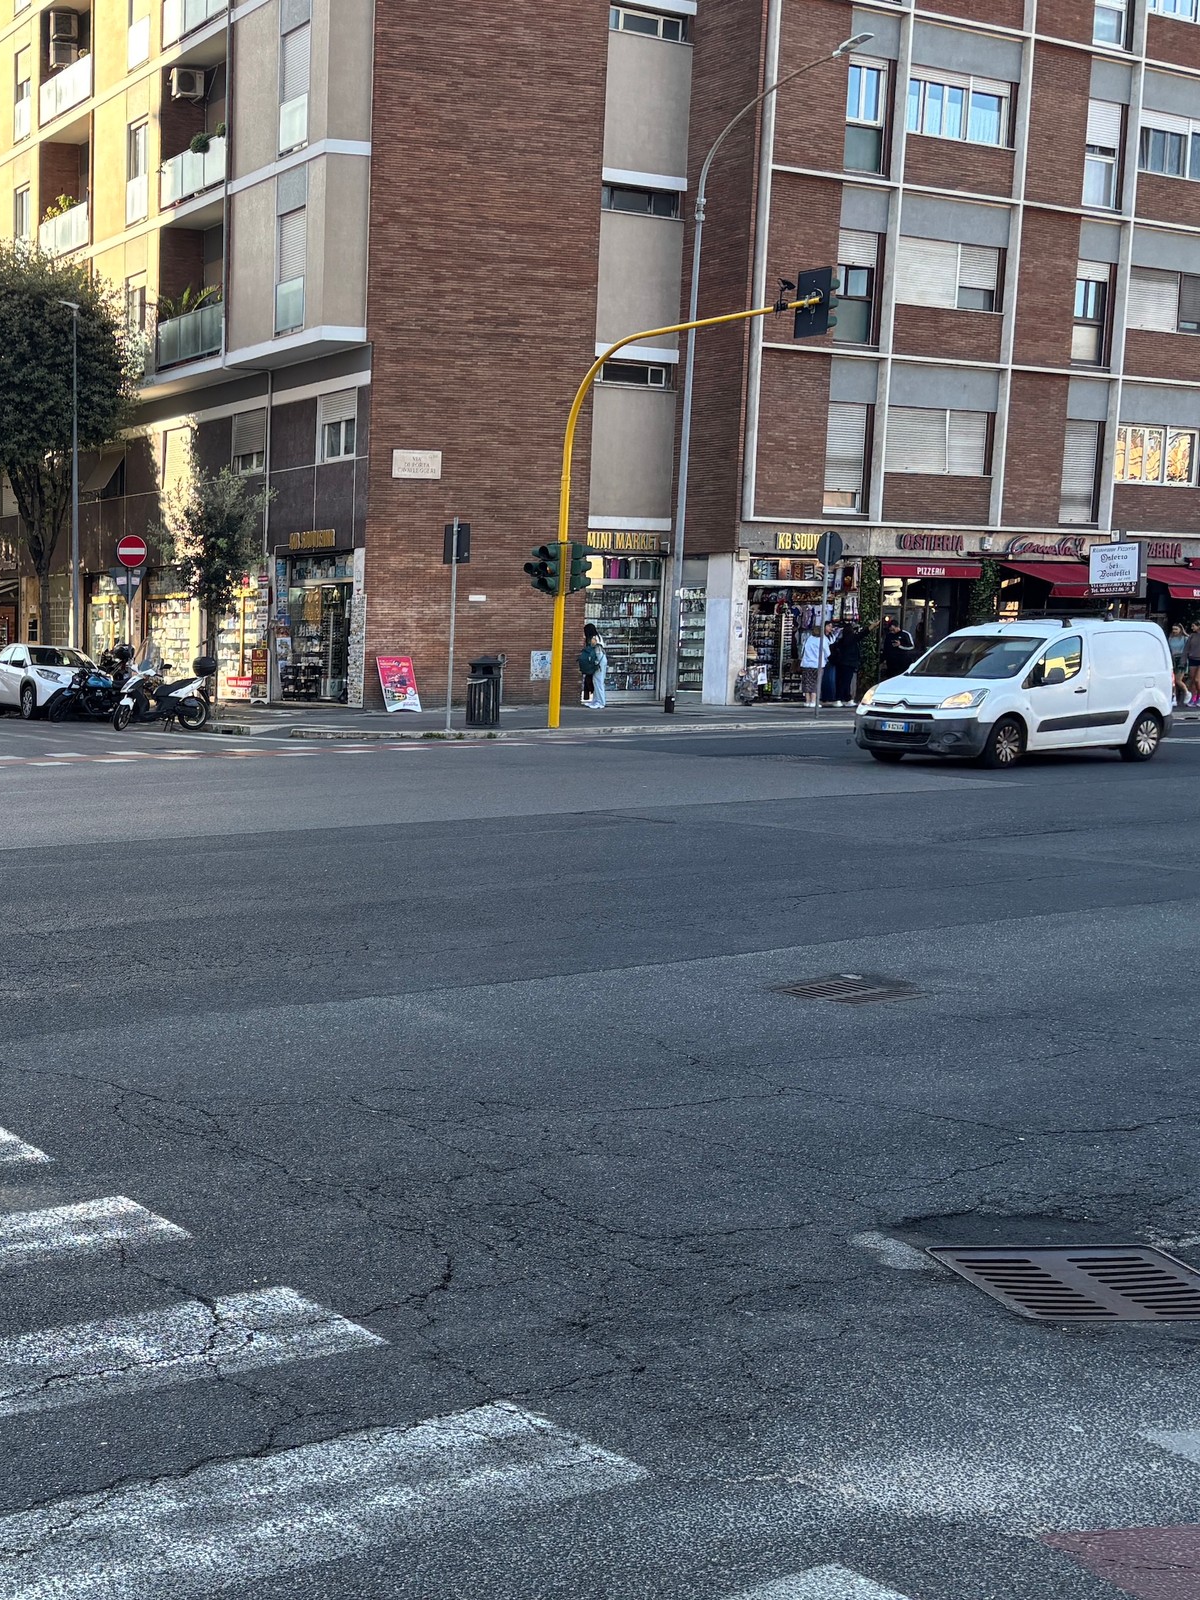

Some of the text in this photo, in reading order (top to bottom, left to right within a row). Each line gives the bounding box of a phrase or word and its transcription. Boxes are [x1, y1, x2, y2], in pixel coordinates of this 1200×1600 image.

[587, 531, 660, 550] MINI MARKET
[777, 532, 822, 550] KB SOUV
[902, 534, 964, 551] OSTERIA
[916, 567, 946, 576] PIZZERIA
